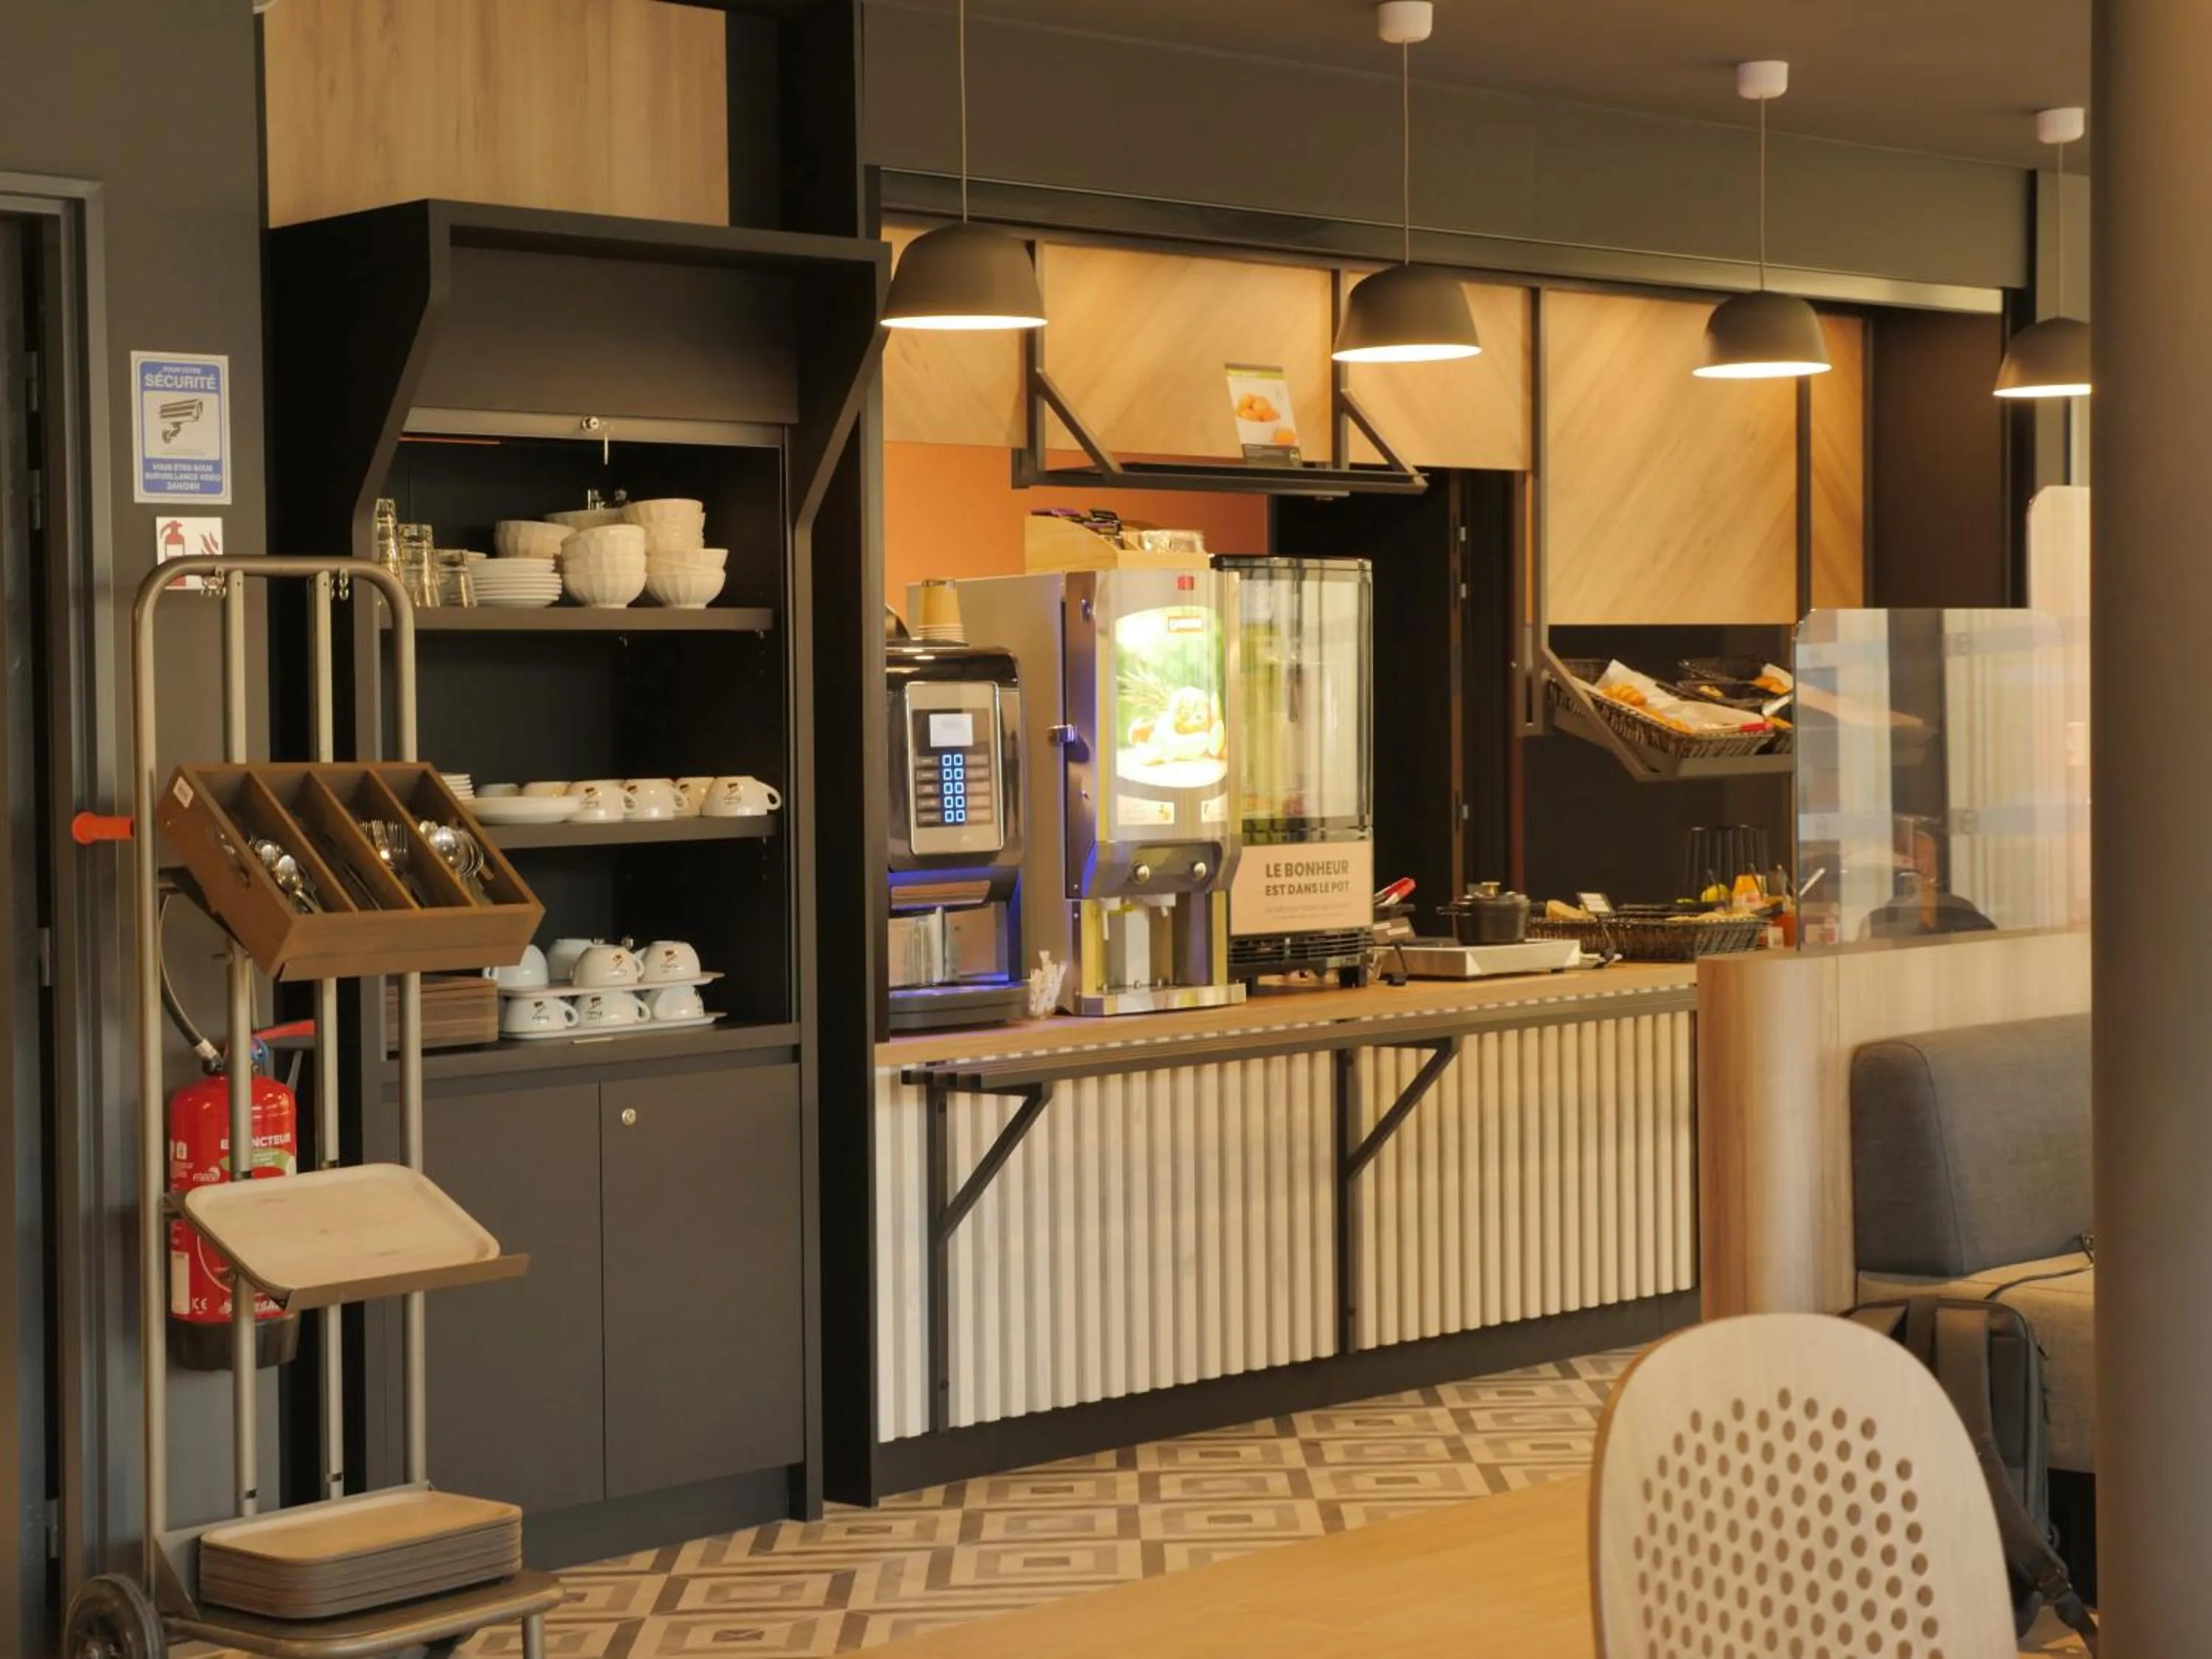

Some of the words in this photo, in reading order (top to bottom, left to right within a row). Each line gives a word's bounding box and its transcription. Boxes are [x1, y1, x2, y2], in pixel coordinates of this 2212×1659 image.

[145, 372, 218, 390] SÉCURITÉ
[1265, 863, 1282, 878] LE
[1284, 860, 1349, 877] BONHEUR
[1265, 884, 1285, 897] EST
[1288, 883, 1318, 895] DANS
[1319, 883, 1329, 894] LE
[1331, 880, 1349, 893] POT
